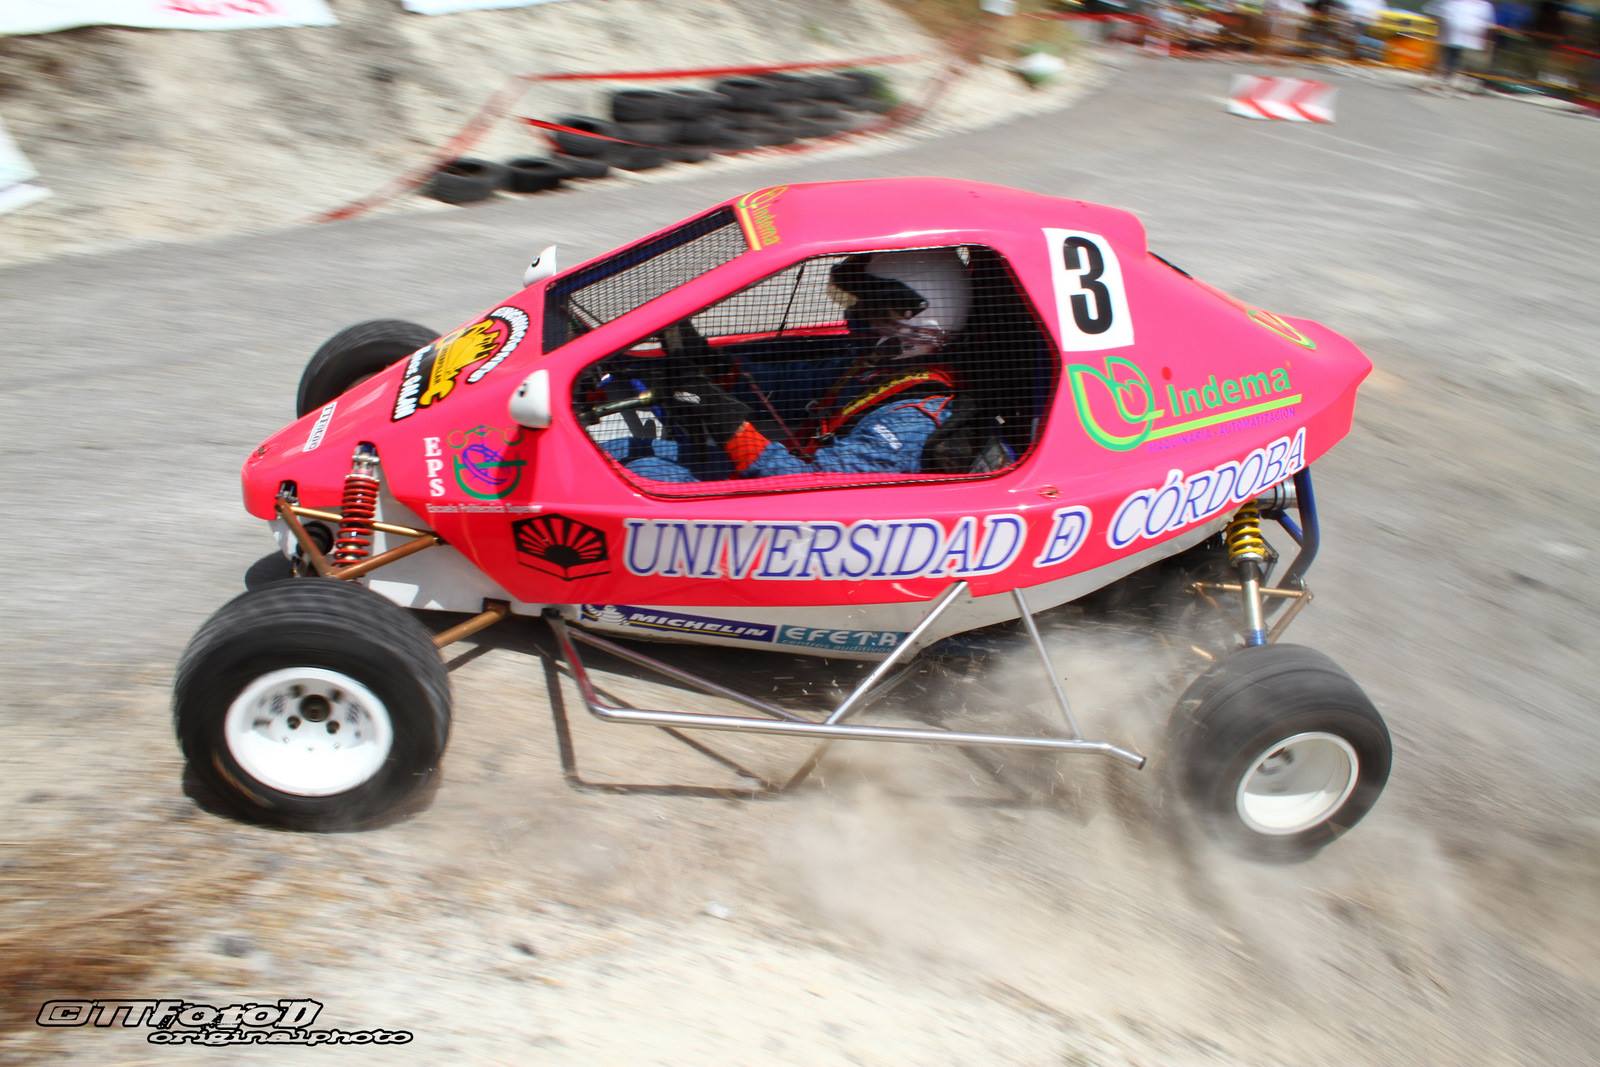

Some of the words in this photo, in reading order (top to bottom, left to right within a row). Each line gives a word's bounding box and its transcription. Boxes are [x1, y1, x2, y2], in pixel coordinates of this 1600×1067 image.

[1063, 235, 1113, 335] 3
[624, 515, 1023, 579] UNIVERSIDAD
[1109, 429, 1305, 548] CÓRDOBA
[629, 612, 769, 638] MICHELIN
[784, 627, 899, 647] EFETA
